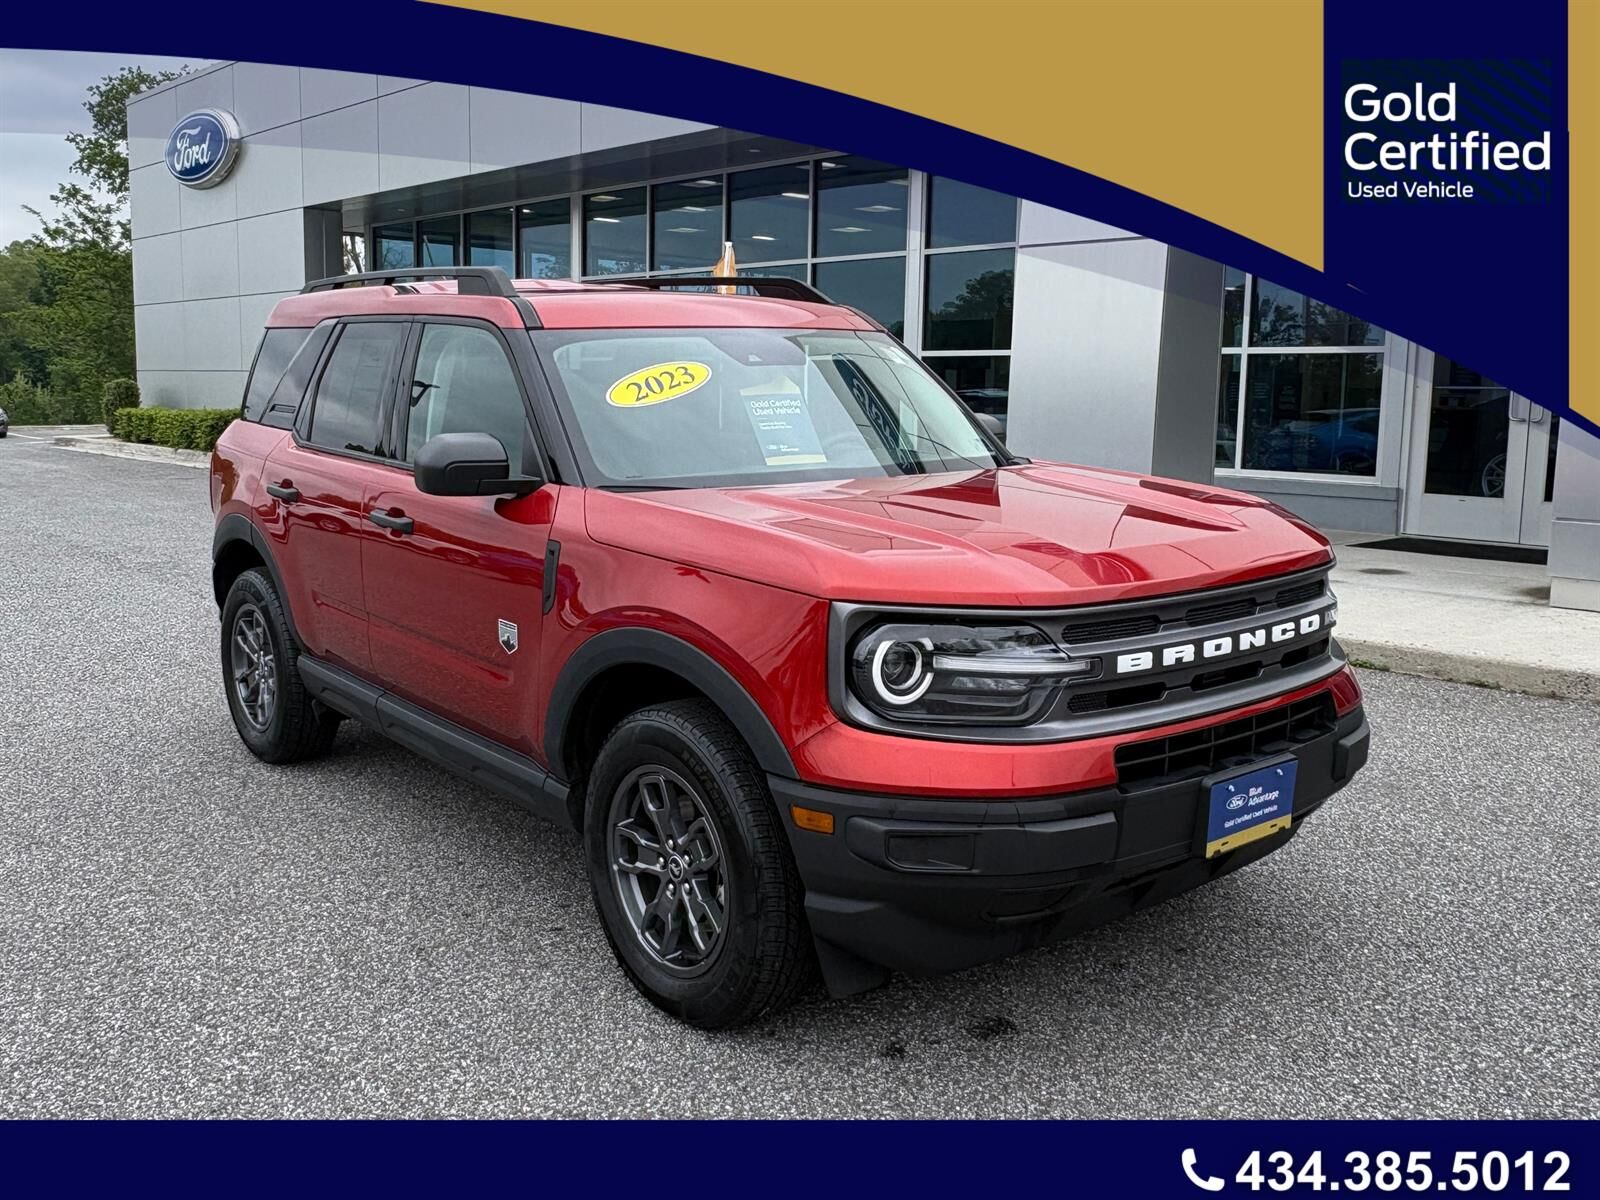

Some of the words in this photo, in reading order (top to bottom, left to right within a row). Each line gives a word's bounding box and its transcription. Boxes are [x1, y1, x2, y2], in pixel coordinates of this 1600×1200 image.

[174, 126, 212, 172] Ford
[626, 366, 696, 402] 2023
[750, 400, 770, 409] Gold
[752, 408, 774, 416] Used
[1116, 614, 1321, 674] BRONCO
